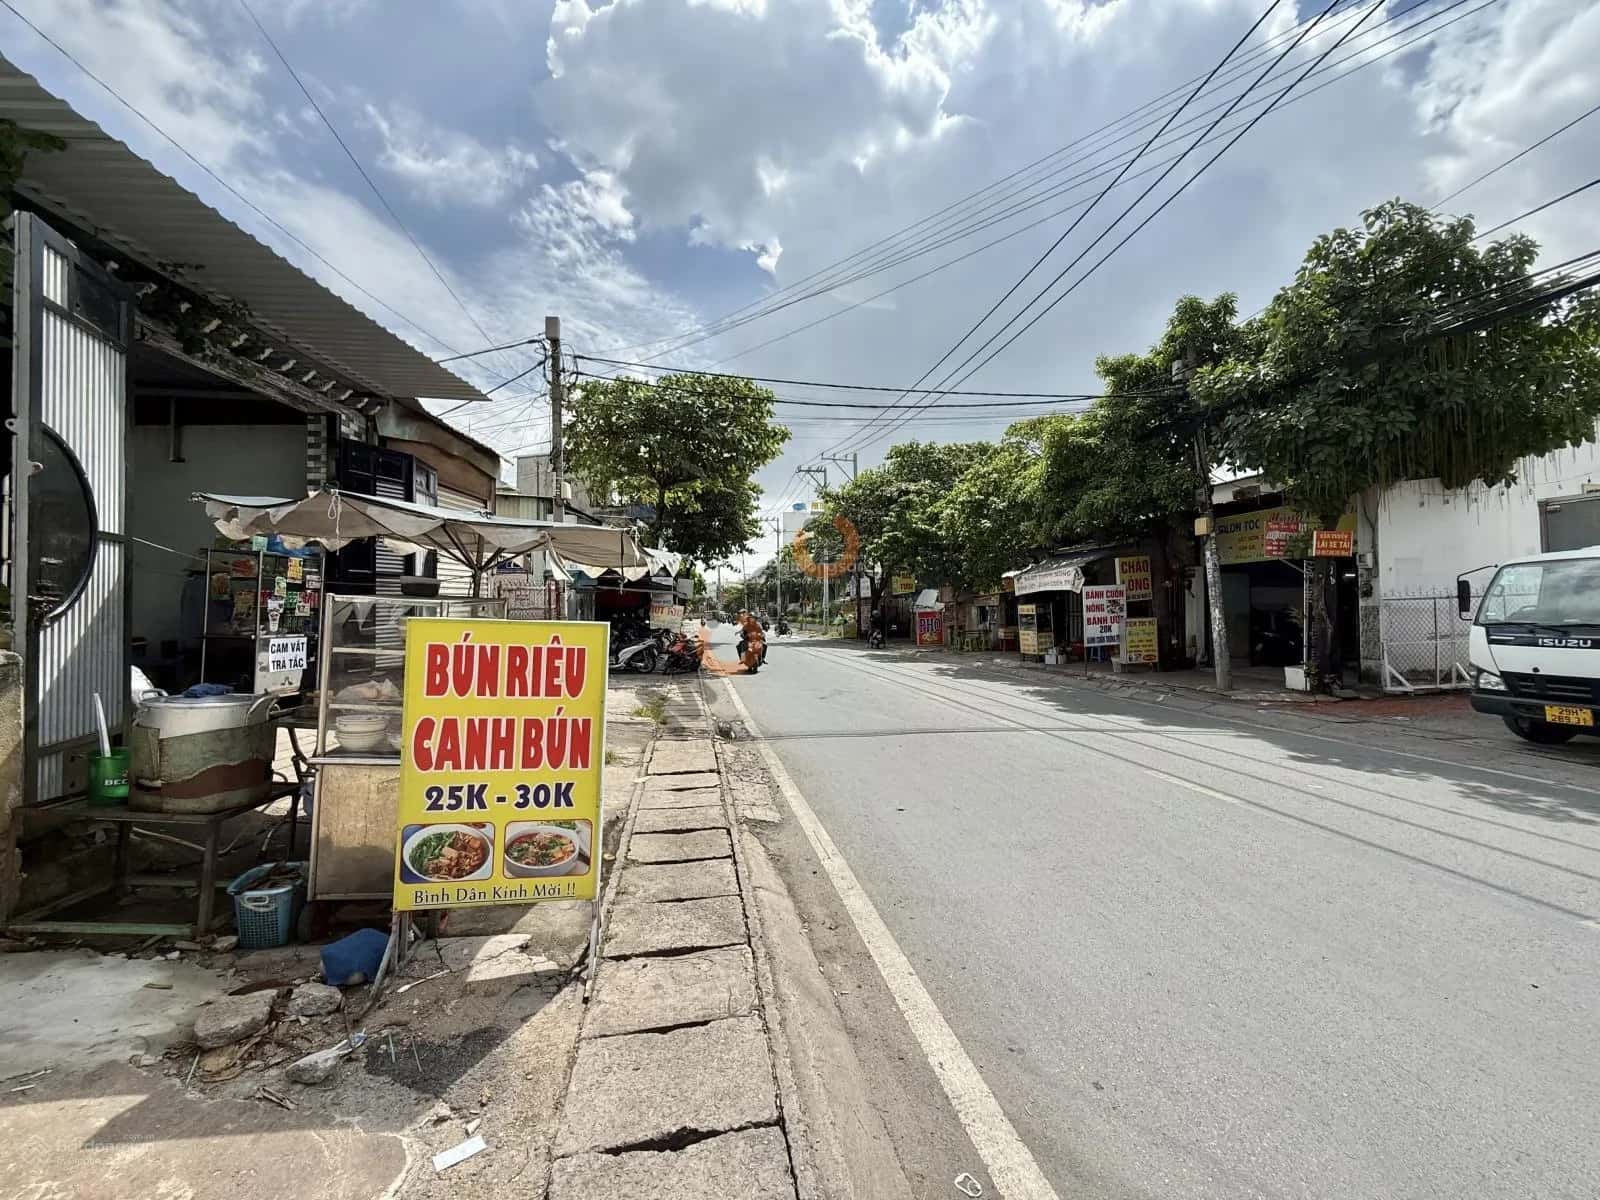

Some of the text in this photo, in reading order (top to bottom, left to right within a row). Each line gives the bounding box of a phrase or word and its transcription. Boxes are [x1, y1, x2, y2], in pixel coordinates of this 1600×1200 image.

[271, 643, 288, 654] CAM
[1538, 638, 1592, 648] ISUZU
[425, 632, 586, 699] BÚN RIÊU
[413, 706, 592, 771] CANH BÚN
[425, 782, 575, 812] 25K - 30K
[414, 882, 576, 904] Bình Dân Kính Mời !!
